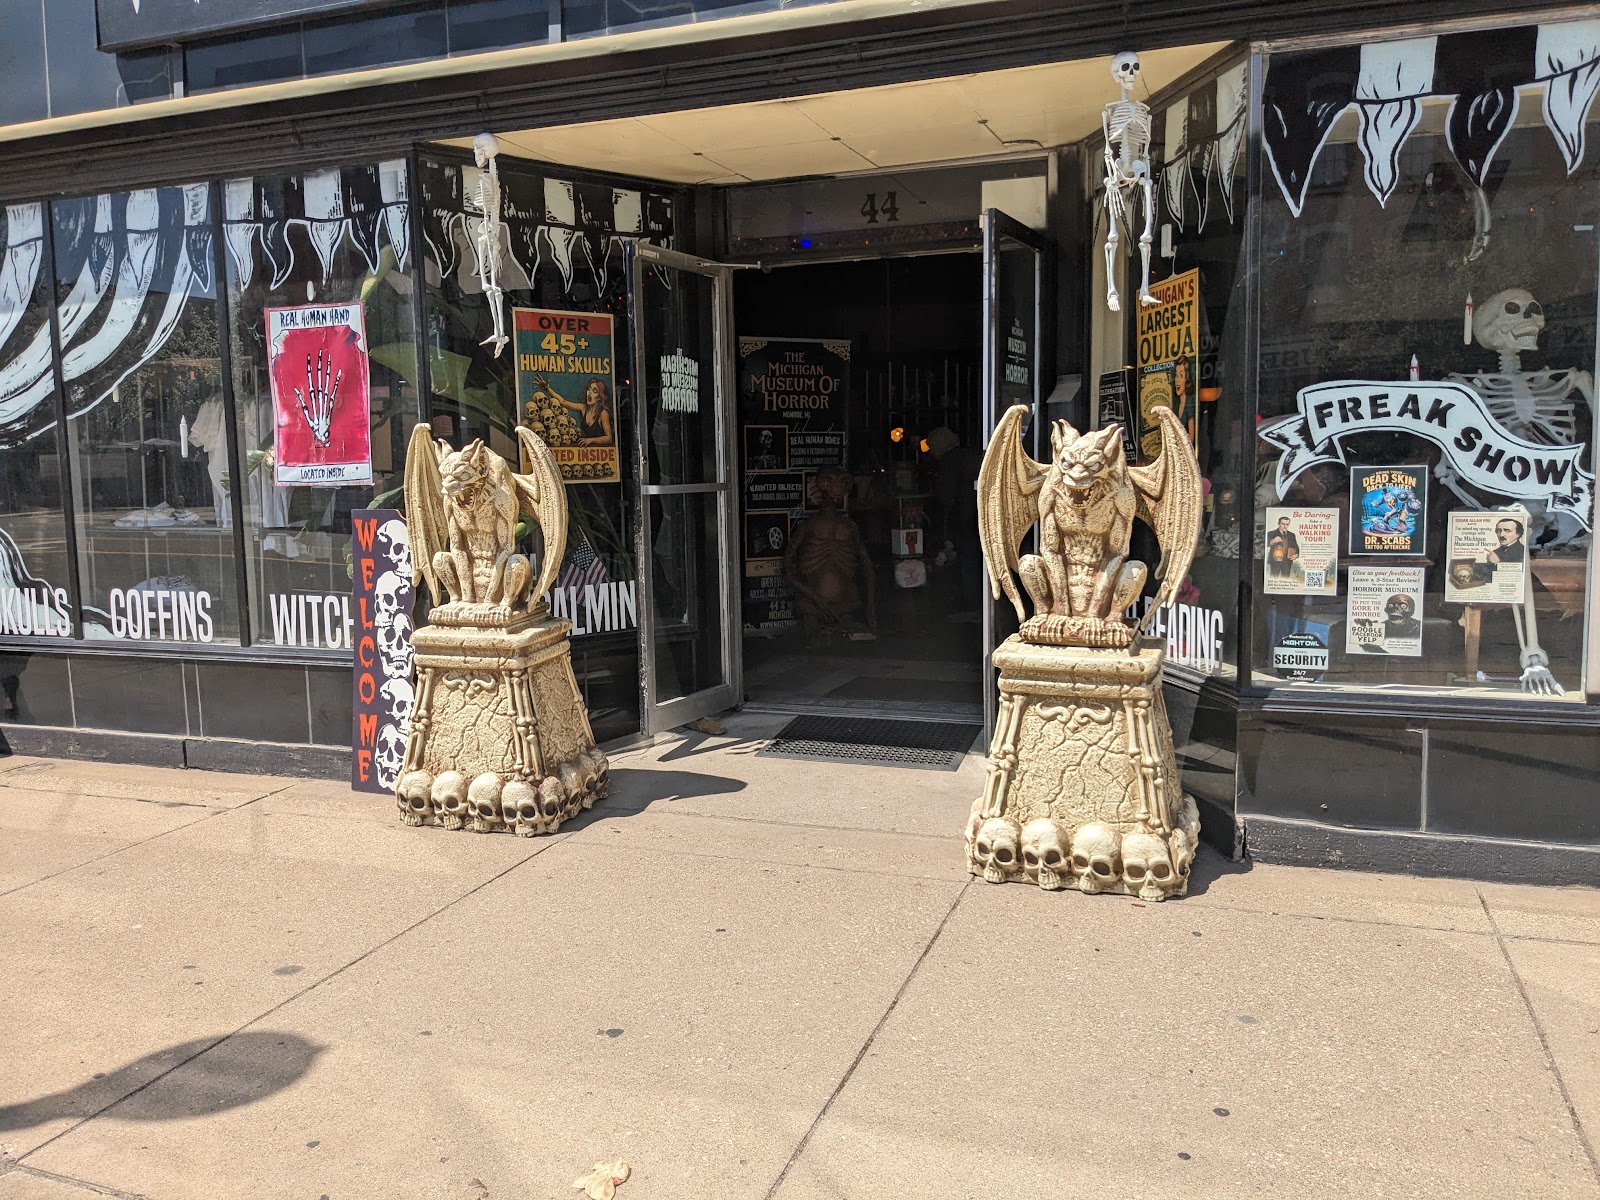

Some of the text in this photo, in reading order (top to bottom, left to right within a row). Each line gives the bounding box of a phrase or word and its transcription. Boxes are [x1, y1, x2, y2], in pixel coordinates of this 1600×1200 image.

[861, 191, 899, 224] 44
[280, 308, 350, 327] REAL HUMAN HAND
[538, 316, 590, 332] OVER
[1141, 300, 1193, 335] LARGEST
[541, 333, 589, 355] 45+
[1008, 337, 1027, 355] MUSEUM
[1140, 326, 1194, 364] OUIJA
[520, 354, 611, 375] HUMAN SKULLS
[784, 351, 806, 363] THE
[768, 361, 824, 377] MICHIGAN
[1006, 363, 1028, 385] HORROR
[1144, 361, 1174, 373] COLLECTION
[750, 373, 816, 393] MUSEUM
[763, 391, 830, 412] HORROR
[790, 436, 804, 446] REAL
[1313, 393, 1571, 486] FREAK SHOW
[578, 449, 615, 462] INSIDE
[300, 467, 345, 480] LOCATED INSIDE
[1362, 474, 1417, 488] DEAD SKIN
[778, 483, 803, 491] OBJECTS
[1366, 483, 1383, 493] BACK
[1364, 536, 1411, 545] DR. SCABS
[110, 588, 213, 642] COFFINS
[353, 518, 378, 783] WELCOME
[1274, 654, 1327, 666] SECURITY
